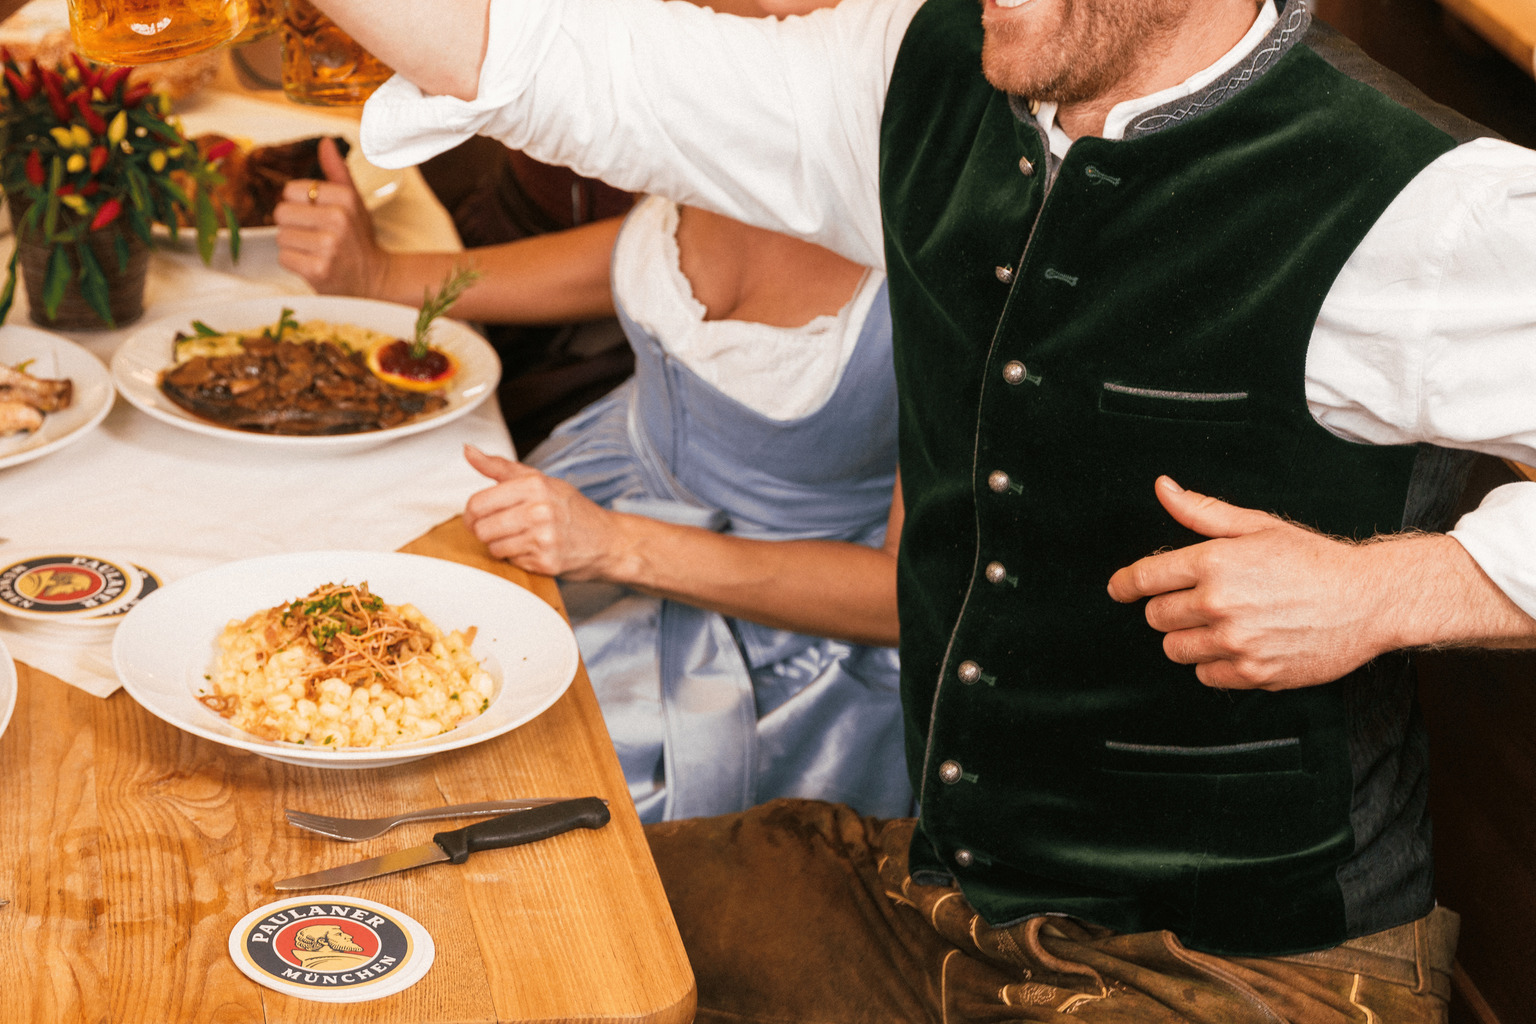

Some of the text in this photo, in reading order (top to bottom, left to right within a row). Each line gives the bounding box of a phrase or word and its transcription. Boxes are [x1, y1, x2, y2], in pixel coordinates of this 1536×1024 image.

[71, 556, 125, 608] PAULANER
[251, 905, 385, 944] PAULANER
[280, 954, 397, 985] MÜNCHEN
